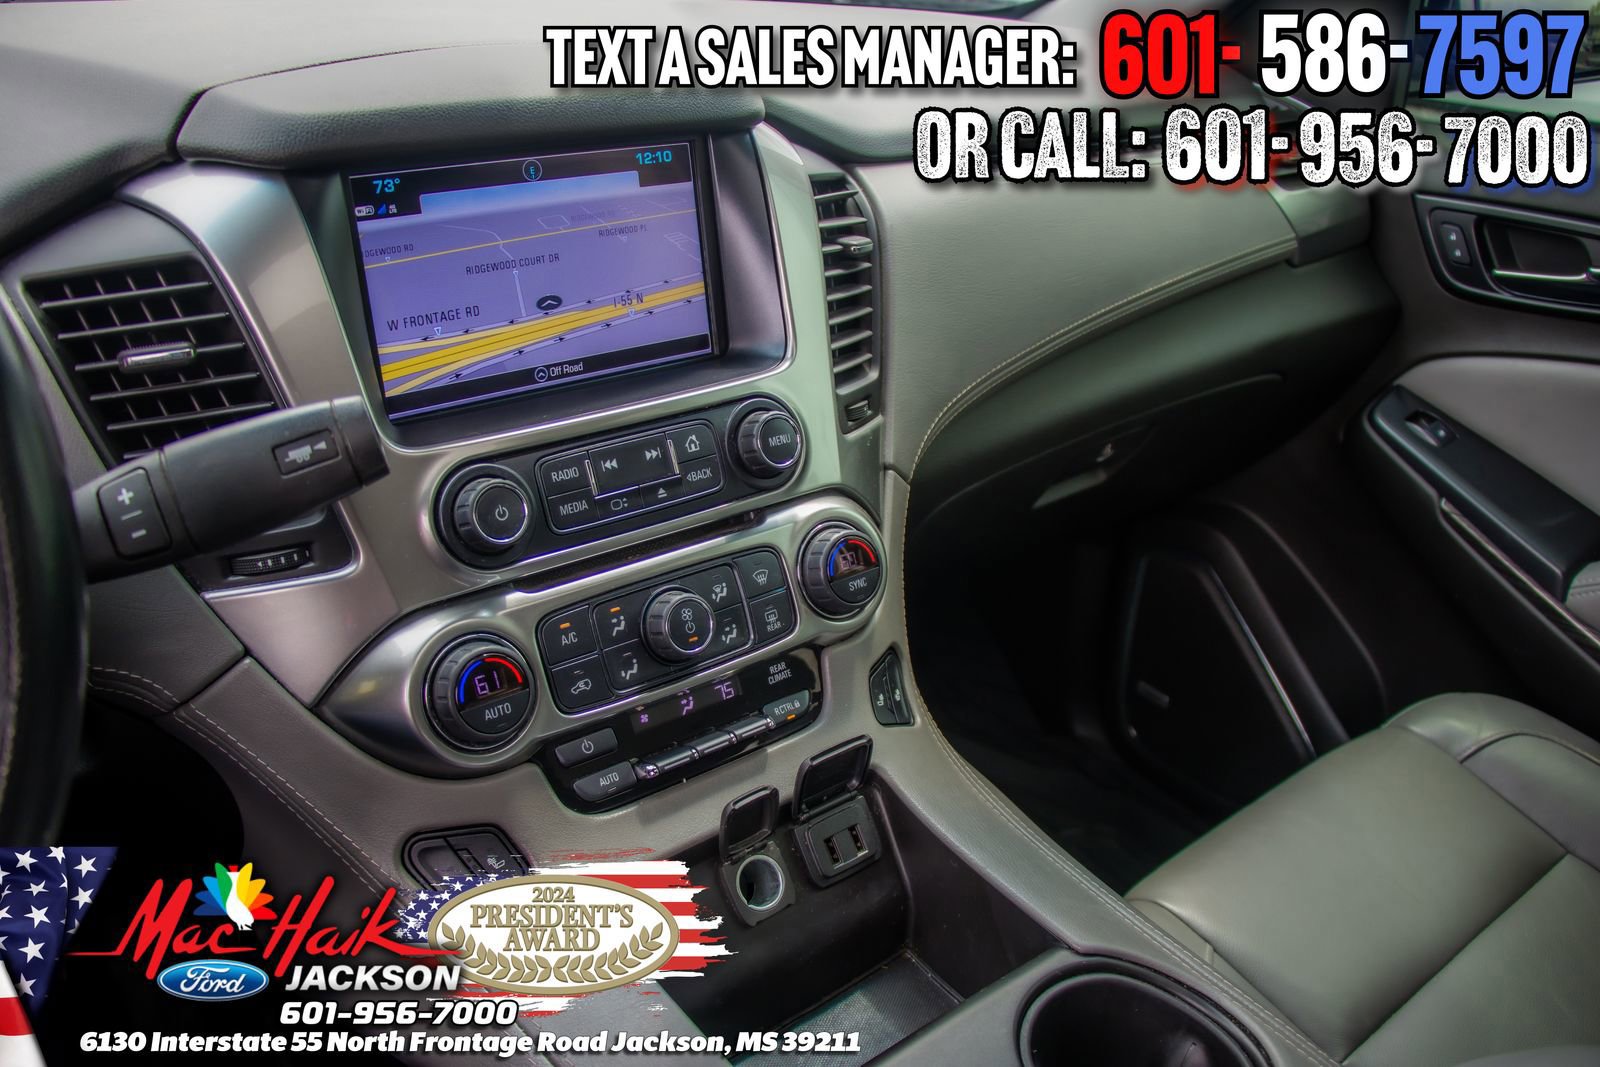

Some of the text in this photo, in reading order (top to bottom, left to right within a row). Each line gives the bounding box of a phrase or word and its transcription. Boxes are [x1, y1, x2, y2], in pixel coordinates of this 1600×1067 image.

[635, 150, 673, 165] 12:10
[373, 178, 400, 194] 73°
[598, 226, 639, 237] RIDGEWOOD
[403, 243, 414, 252] RD
[466, 252, 560, 275] RIDGEWOOD COURT DR
[613, 292, 644, 308] I-55 N
[387, 305, 480, 332] W FRONTAGE RD
[550, 362, 584, 377] Off Road
[768, 433, 791, 447] MENU
[551, 466, 580, 483] RADIO
[690, 467, 713, 481] BACK
[559, 499, 589, 516] MEDIA
[848, 577, 868, 592] SYNC
[766, 623, 782, 633] REAR
[561, 631, 578, 646] A/C
[769, 661, 787, 674] REAR
[474, 671, 501, 697] 61
[768, 669, 793, 685] CLIMATE
[714, 682, 736, 701] 75
[484, 702, 512, 721] AUTO
[600, 772, 619, 788] AUTO
